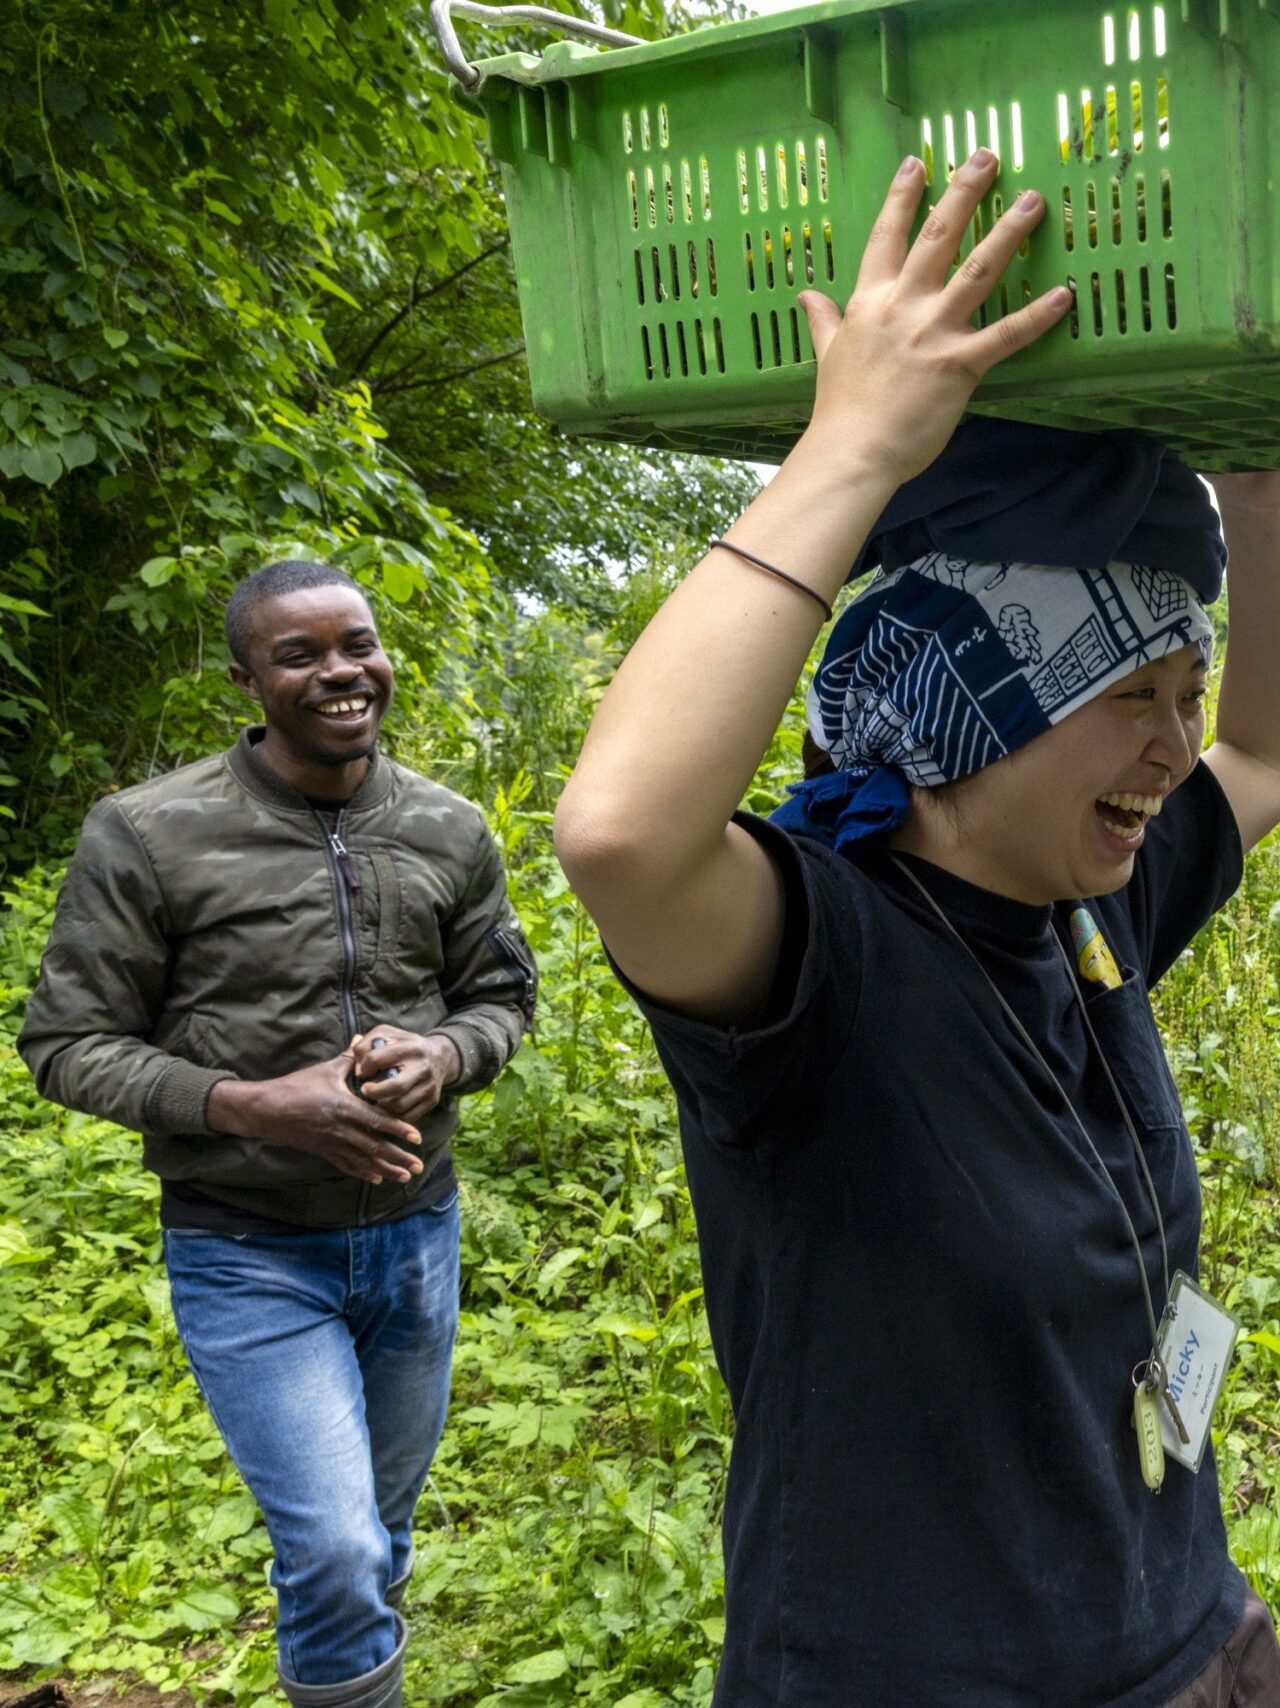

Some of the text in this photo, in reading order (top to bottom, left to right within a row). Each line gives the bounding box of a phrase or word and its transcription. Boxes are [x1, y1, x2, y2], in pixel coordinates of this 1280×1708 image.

[1167, 1328, 1200, 1402] Micky
[1200, 1361, 1219, 1416] Participant
[1143, 1412, 1158, 1463] 203
